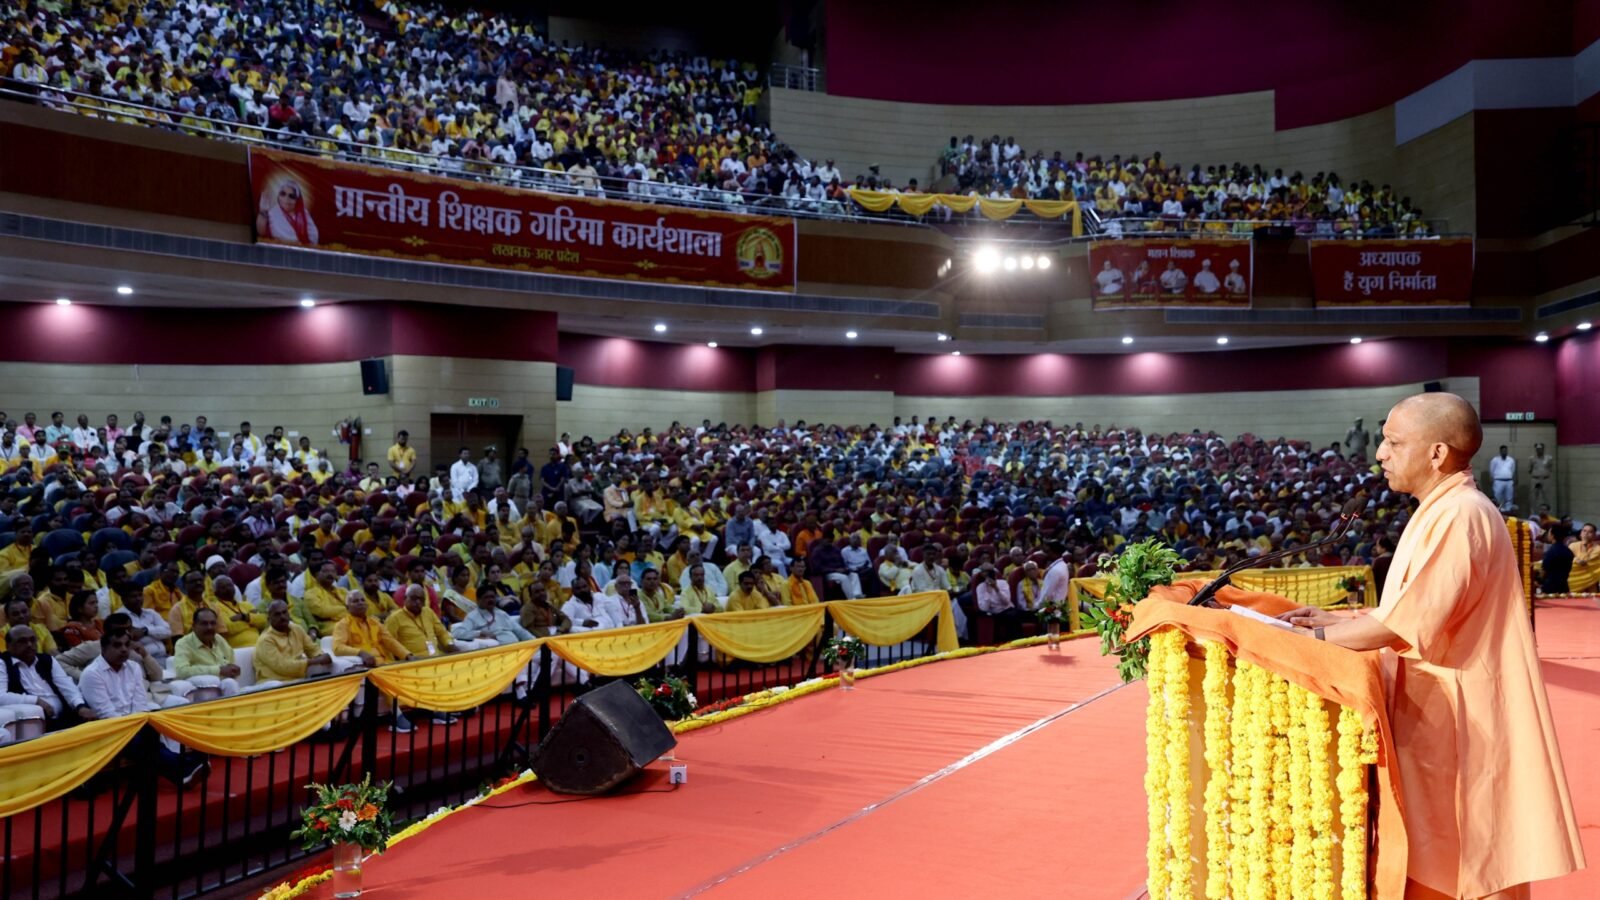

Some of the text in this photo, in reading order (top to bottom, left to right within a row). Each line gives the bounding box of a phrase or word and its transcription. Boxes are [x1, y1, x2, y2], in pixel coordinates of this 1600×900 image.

[333, 183, 431, 227] प्रान्तीय
[438, 191, 523, 236] शिक्षक
[530, 205, 604, 246] गरिमा
[611, 217, 723, 258] कार्यशाला
[1358, 251, 1422, 266] अध्यापक
[1357, 274, 1385, 296] युग
[1387, 270, 1438, 290] निर्माता
[468, 397, 487, 407] EXIT
[1506, 412, 1524, 420] EXIT
